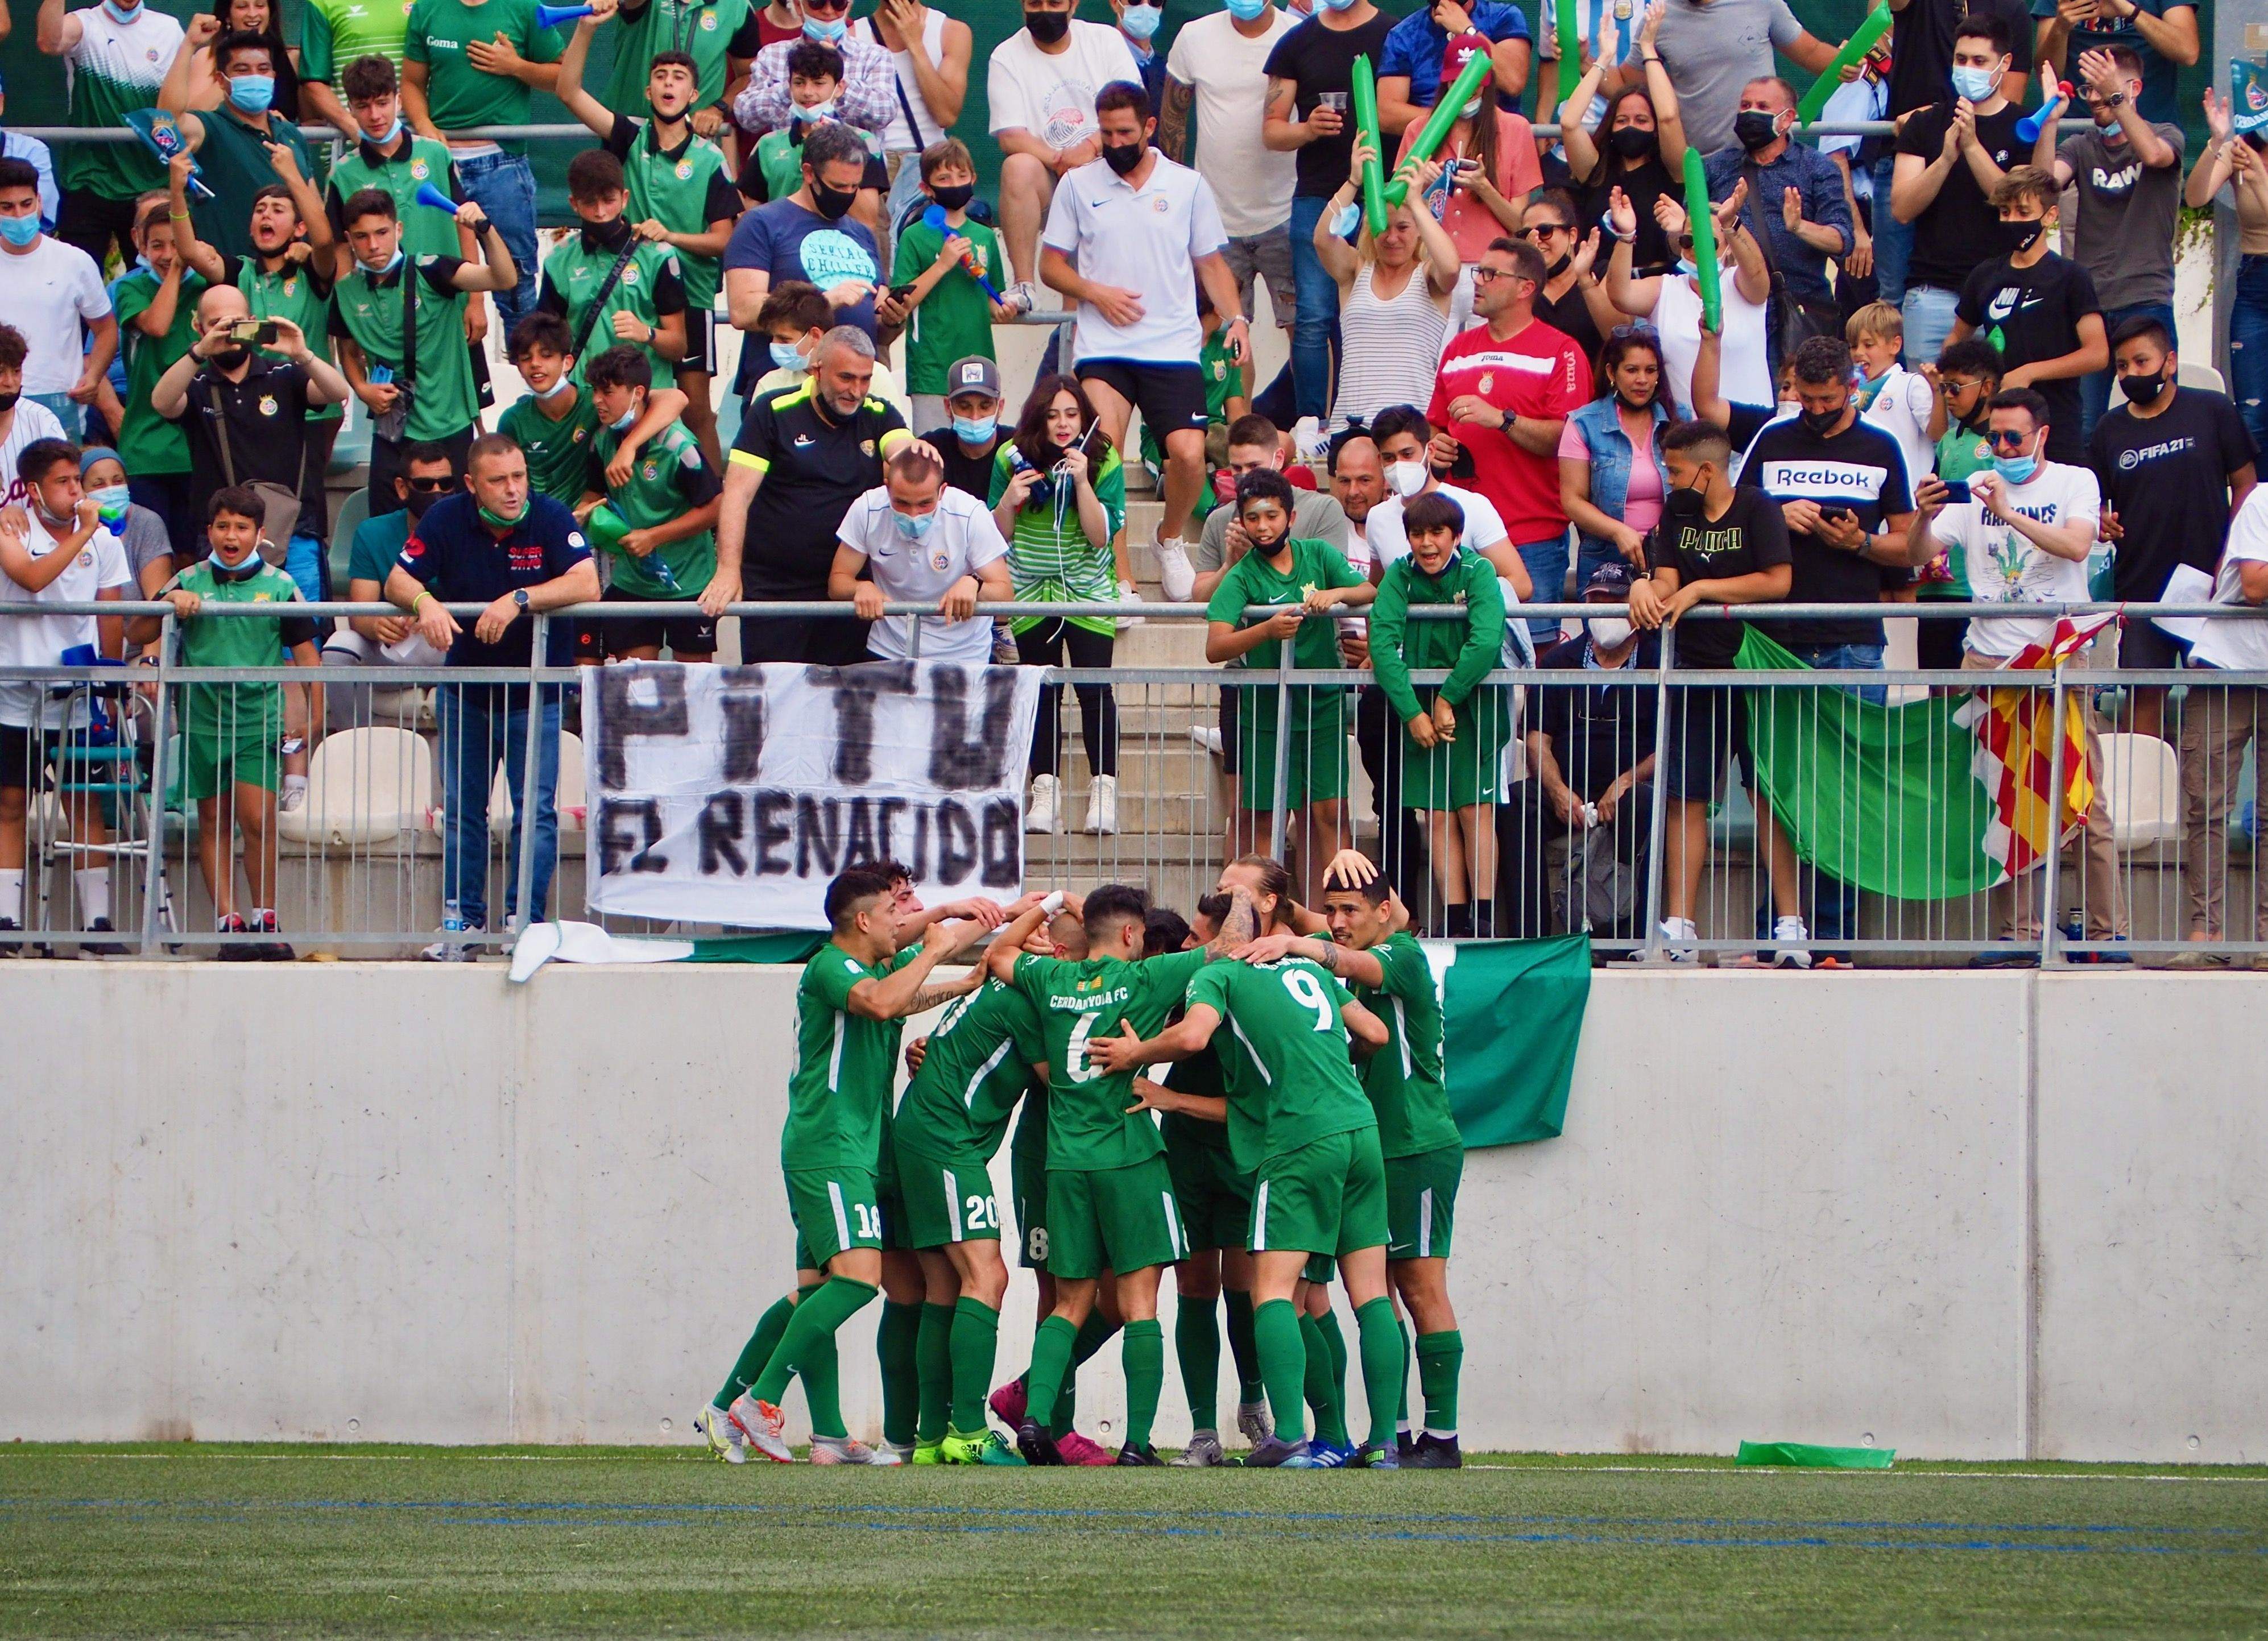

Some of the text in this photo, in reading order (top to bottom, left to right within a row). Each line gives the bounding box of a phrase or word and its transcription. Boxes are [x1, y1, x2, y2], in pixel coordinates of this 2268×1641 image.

[2093, 161, 2142, 188] RAW
[809, 243, 864, 260] SERIAL
[808, 258, 872, 279] CHILLER
[2139, 442, 2169, 461] FIFA
[2170, 438, 2184, 453] 21
[1777, 469, 1869, 487] Reebok
[1049, 987, 1128, 1010] CERDANYOLA FC
[1282, 968, 1333, 1031] 9
[1067, 1012, 1103, 1083] 6
[854, 1203, 881, 1240] 18
[966, 1194, 1000, 1230] 20
[1029, 1226, 1049, 1261] 8
